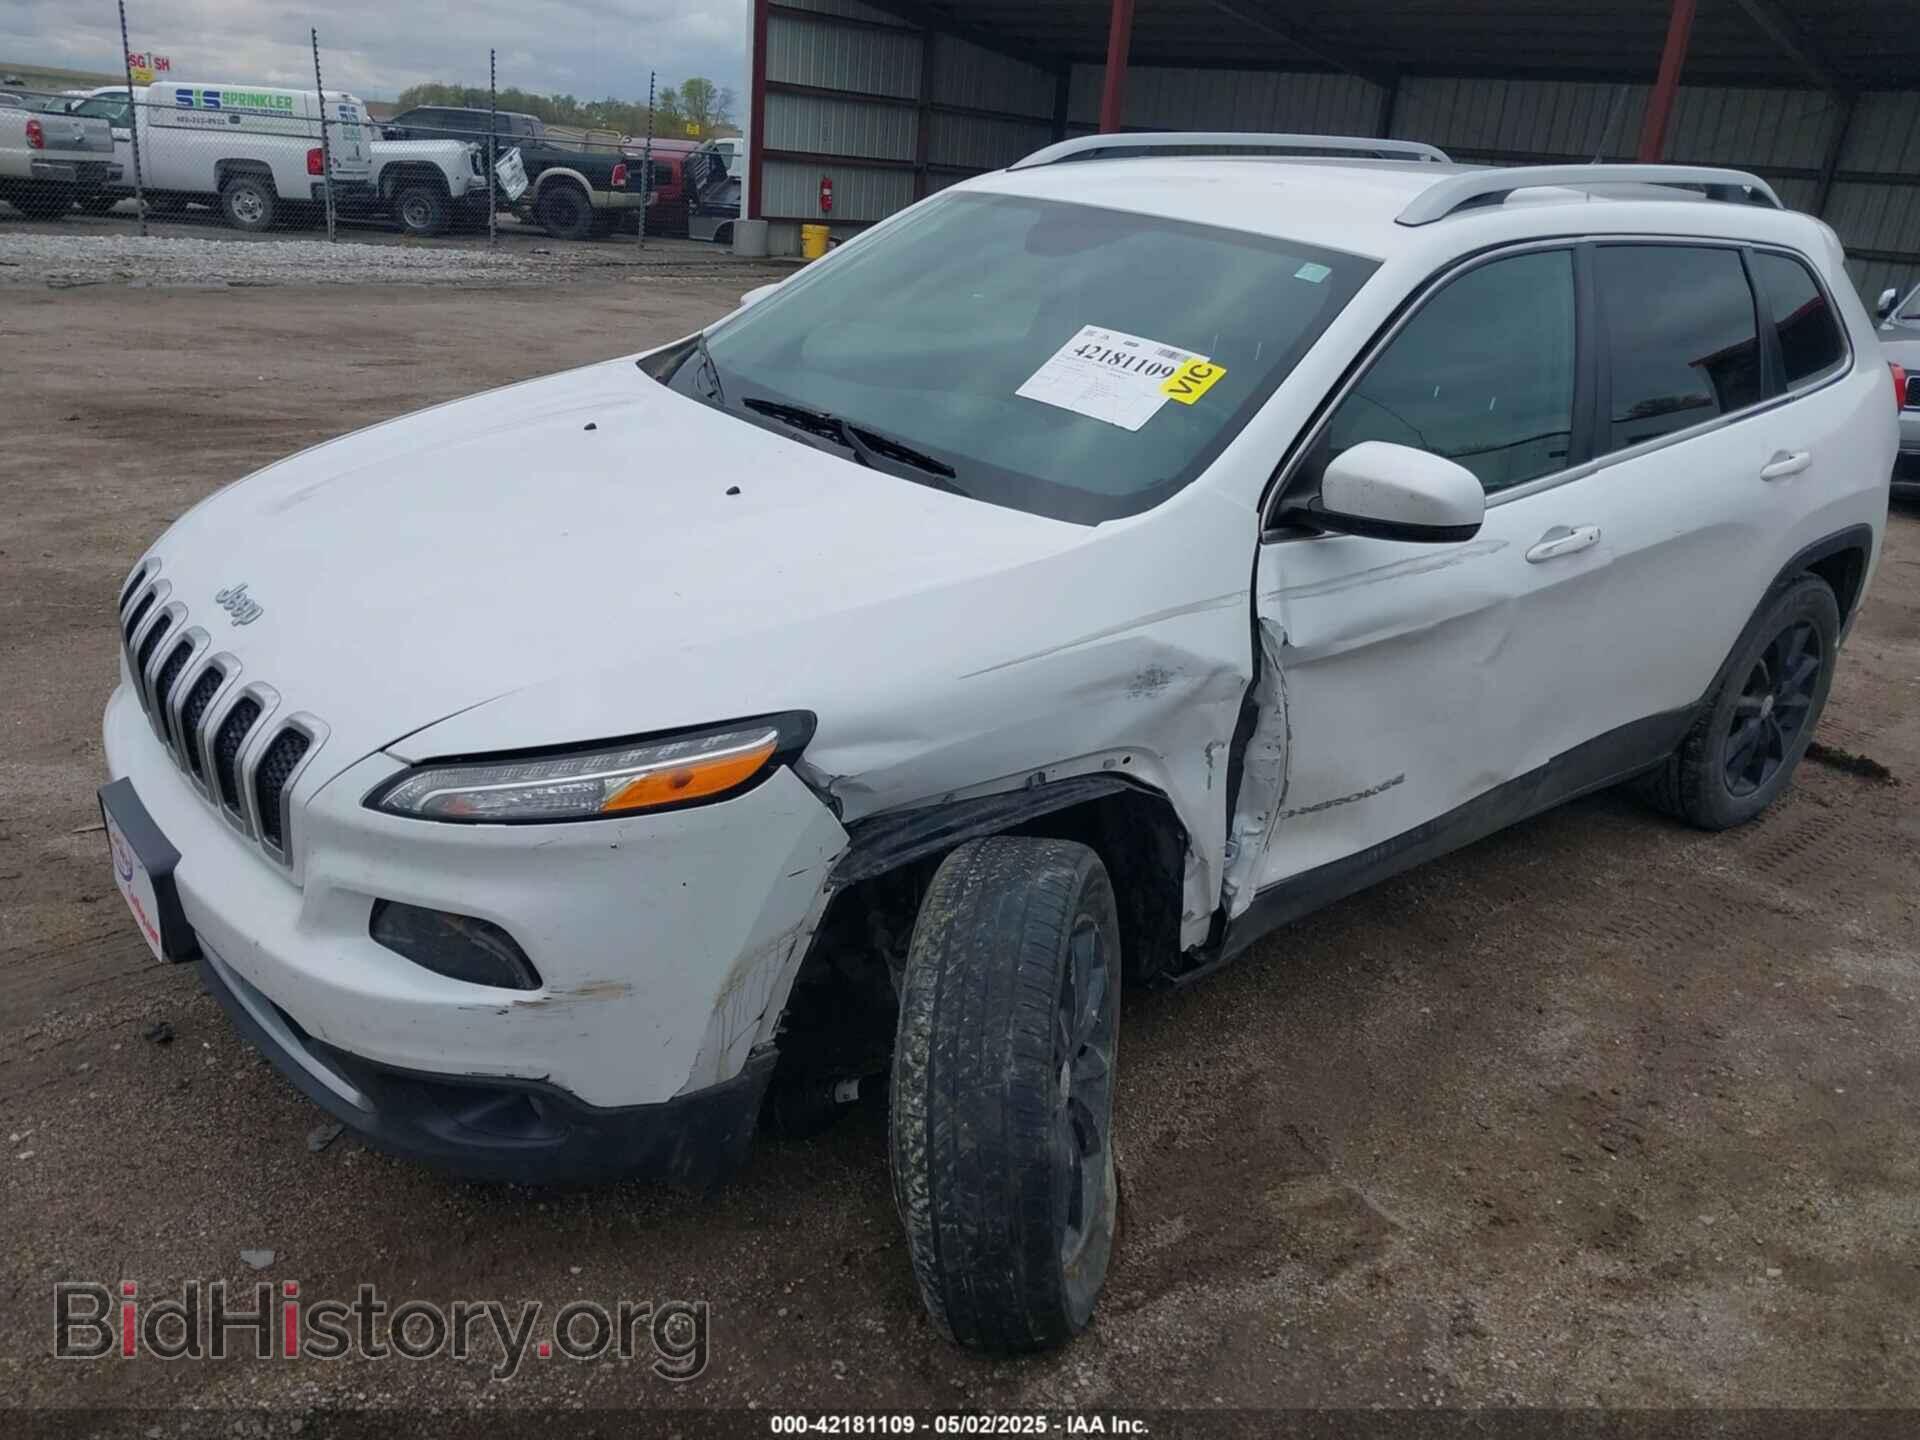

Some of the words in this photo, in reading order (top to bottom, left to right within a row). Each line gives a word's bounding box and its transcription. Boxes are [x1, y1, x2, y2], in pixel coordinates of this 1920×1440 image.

[222, 91, 293, 110] SPRINKLER
[1073, 343, 1176, 380] 42181109
[1167, 364, 1213, 396] VIC
[216, 583, 264, 627] Jeep
